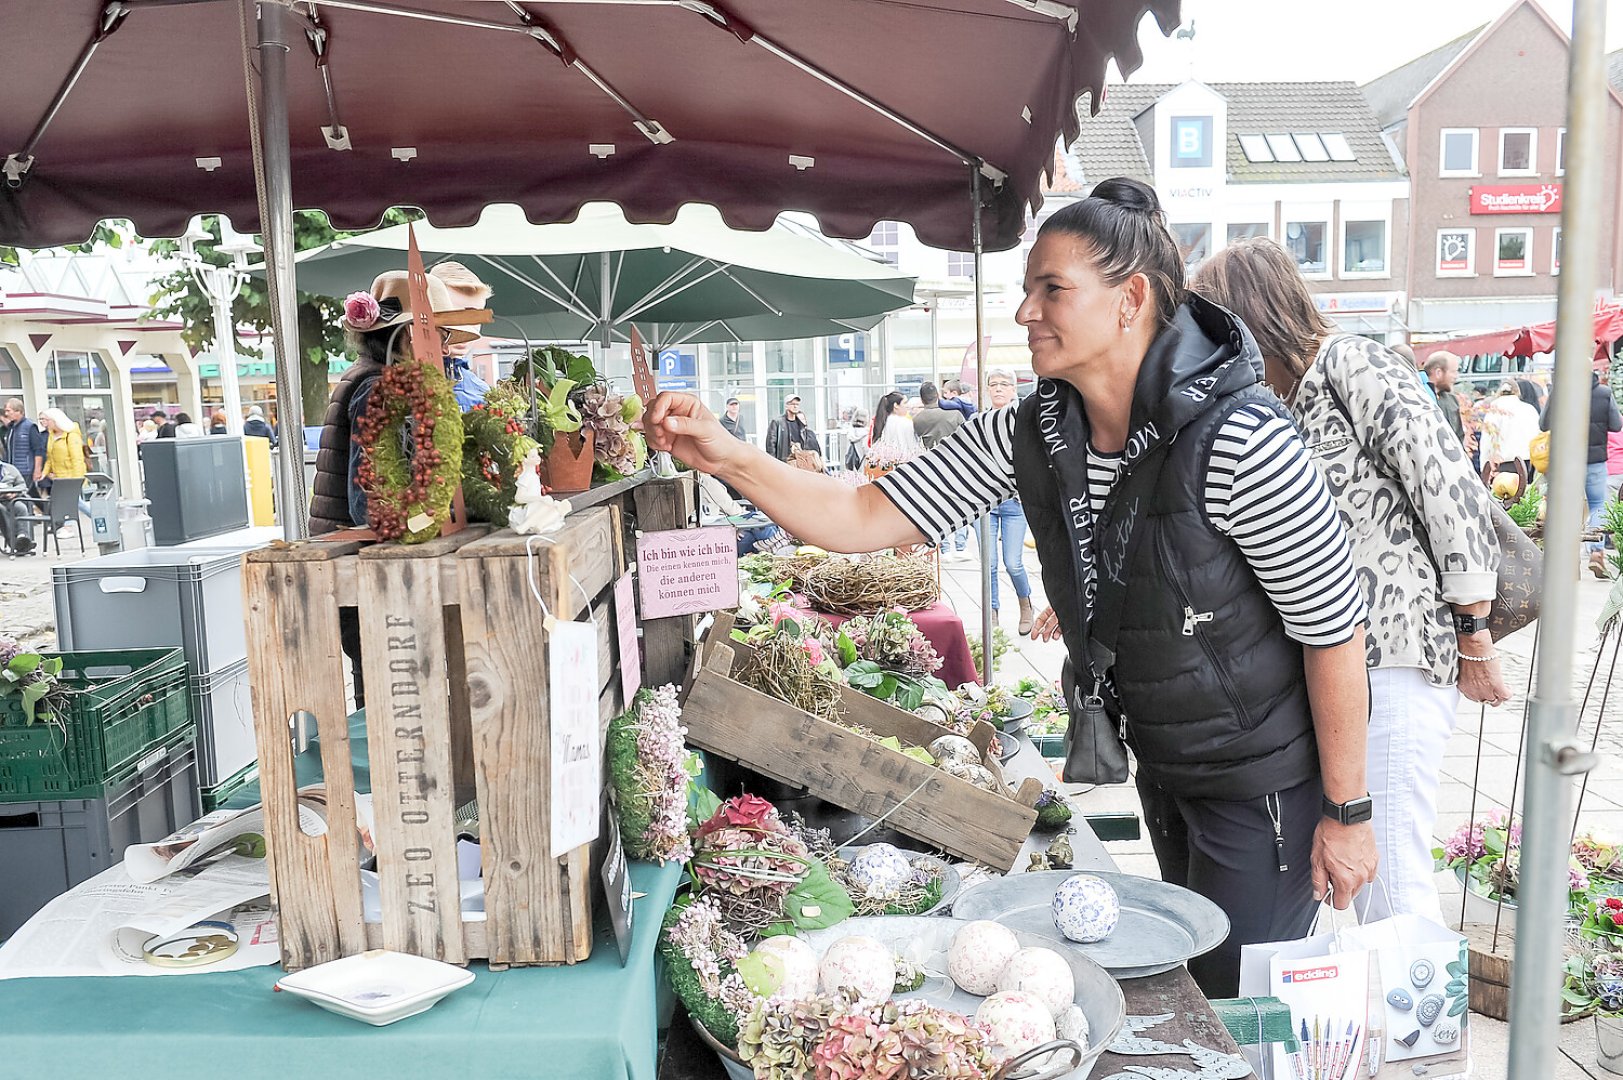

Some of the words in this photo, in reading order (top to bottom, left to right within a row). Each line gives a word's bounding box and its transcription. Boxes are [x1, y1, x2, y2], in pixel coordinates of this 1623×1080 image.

[1169, 187, 1213, 198] VIACTIV
[1480, 192, 1547, 206] Studienkreis
[665, 358, 675, 375] P
[642, 548, 659, 562] Ich
[660, 547, 677, 560] bin
[679, 545, 696, 557] wie
[698, 543, 713, 556] ich
[714, 542, 734, 554] bin.
[646, 564, 660, 573] Die
[660, 562, 682, 571] einen
[683, 560, 710, 569] kennen
[711, 557, 731, 566] mich,
[660, 575, 675, 586] die
[677, 572, 717, 584] anderen
[697, 583, 721, 595] mich
[386, 613, 430, 826] OTTERNDORF
[403, 845, 437, 917] ZEO
[1293, 967, 1338, 982] edding
